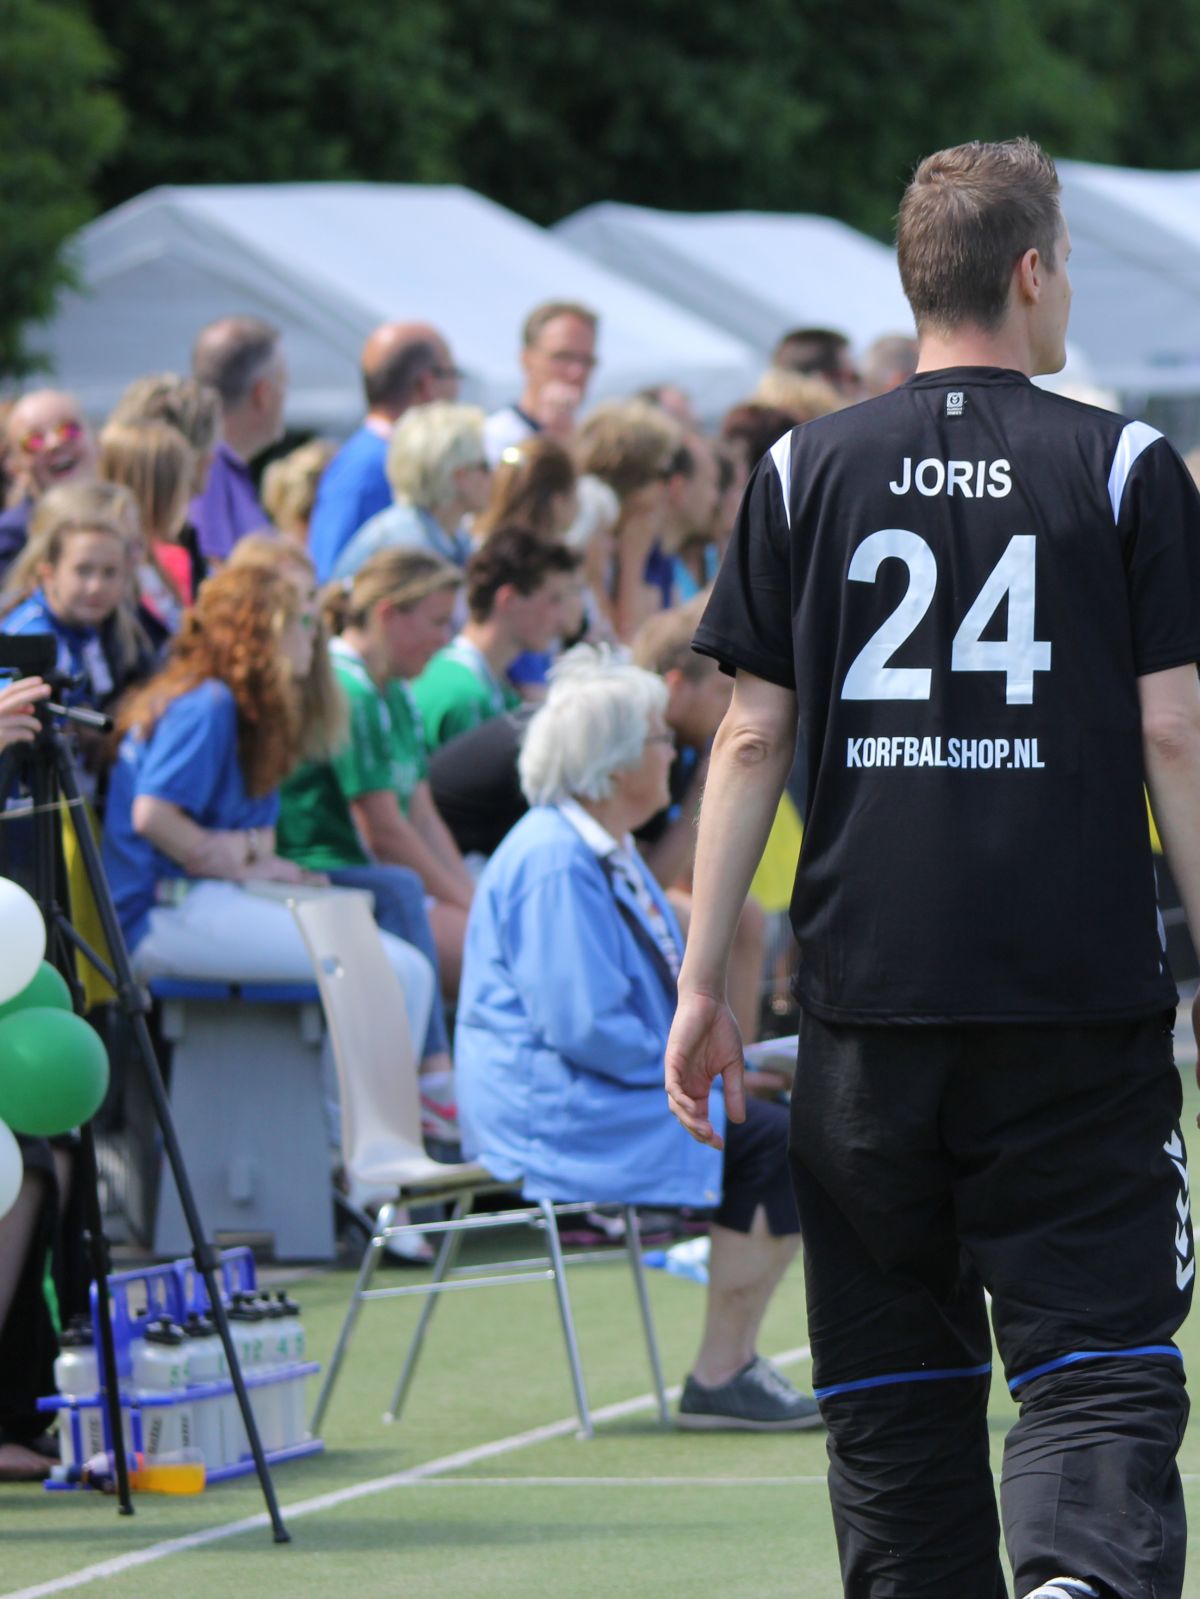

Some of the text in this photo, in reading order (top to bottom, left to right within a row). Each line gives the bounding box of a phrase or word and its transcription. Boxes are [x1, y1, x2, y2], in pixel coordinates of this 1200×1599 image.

[889, 457, 1013, 498] JORIS
[841, 528, 1052, 705] 24
[846, 736, 1046, 769] KORFBALSHOP.NL
